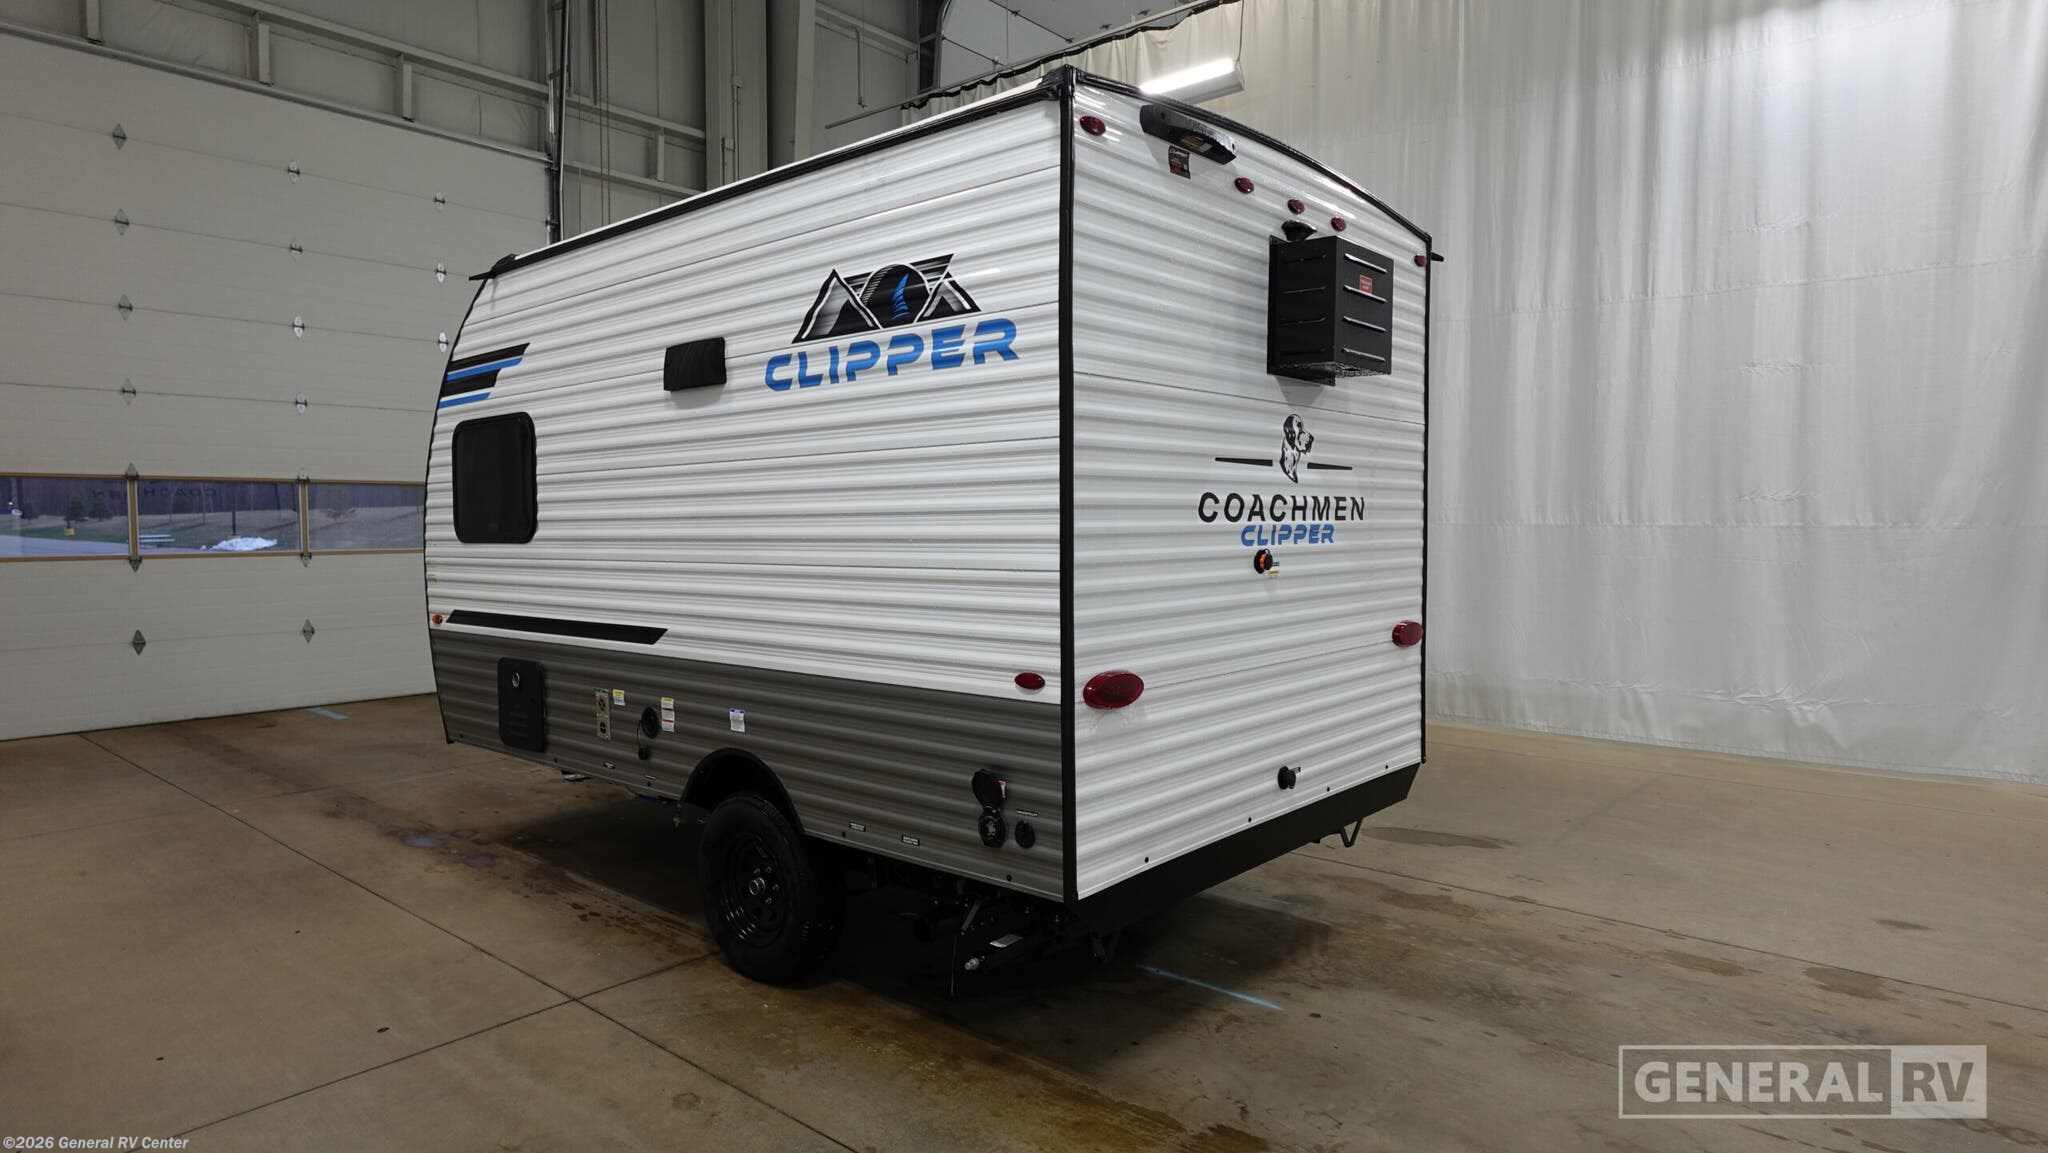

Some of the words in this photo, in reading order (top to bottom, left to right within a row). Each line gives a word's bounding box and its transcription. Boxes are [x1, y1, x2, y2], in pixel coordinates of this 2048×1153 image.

[764, 318, 1020, 392] CLIPPER
[1198, 491, 1365, 523] COACHMEN
[1241, 524, 1335, 547] CLIPPER
